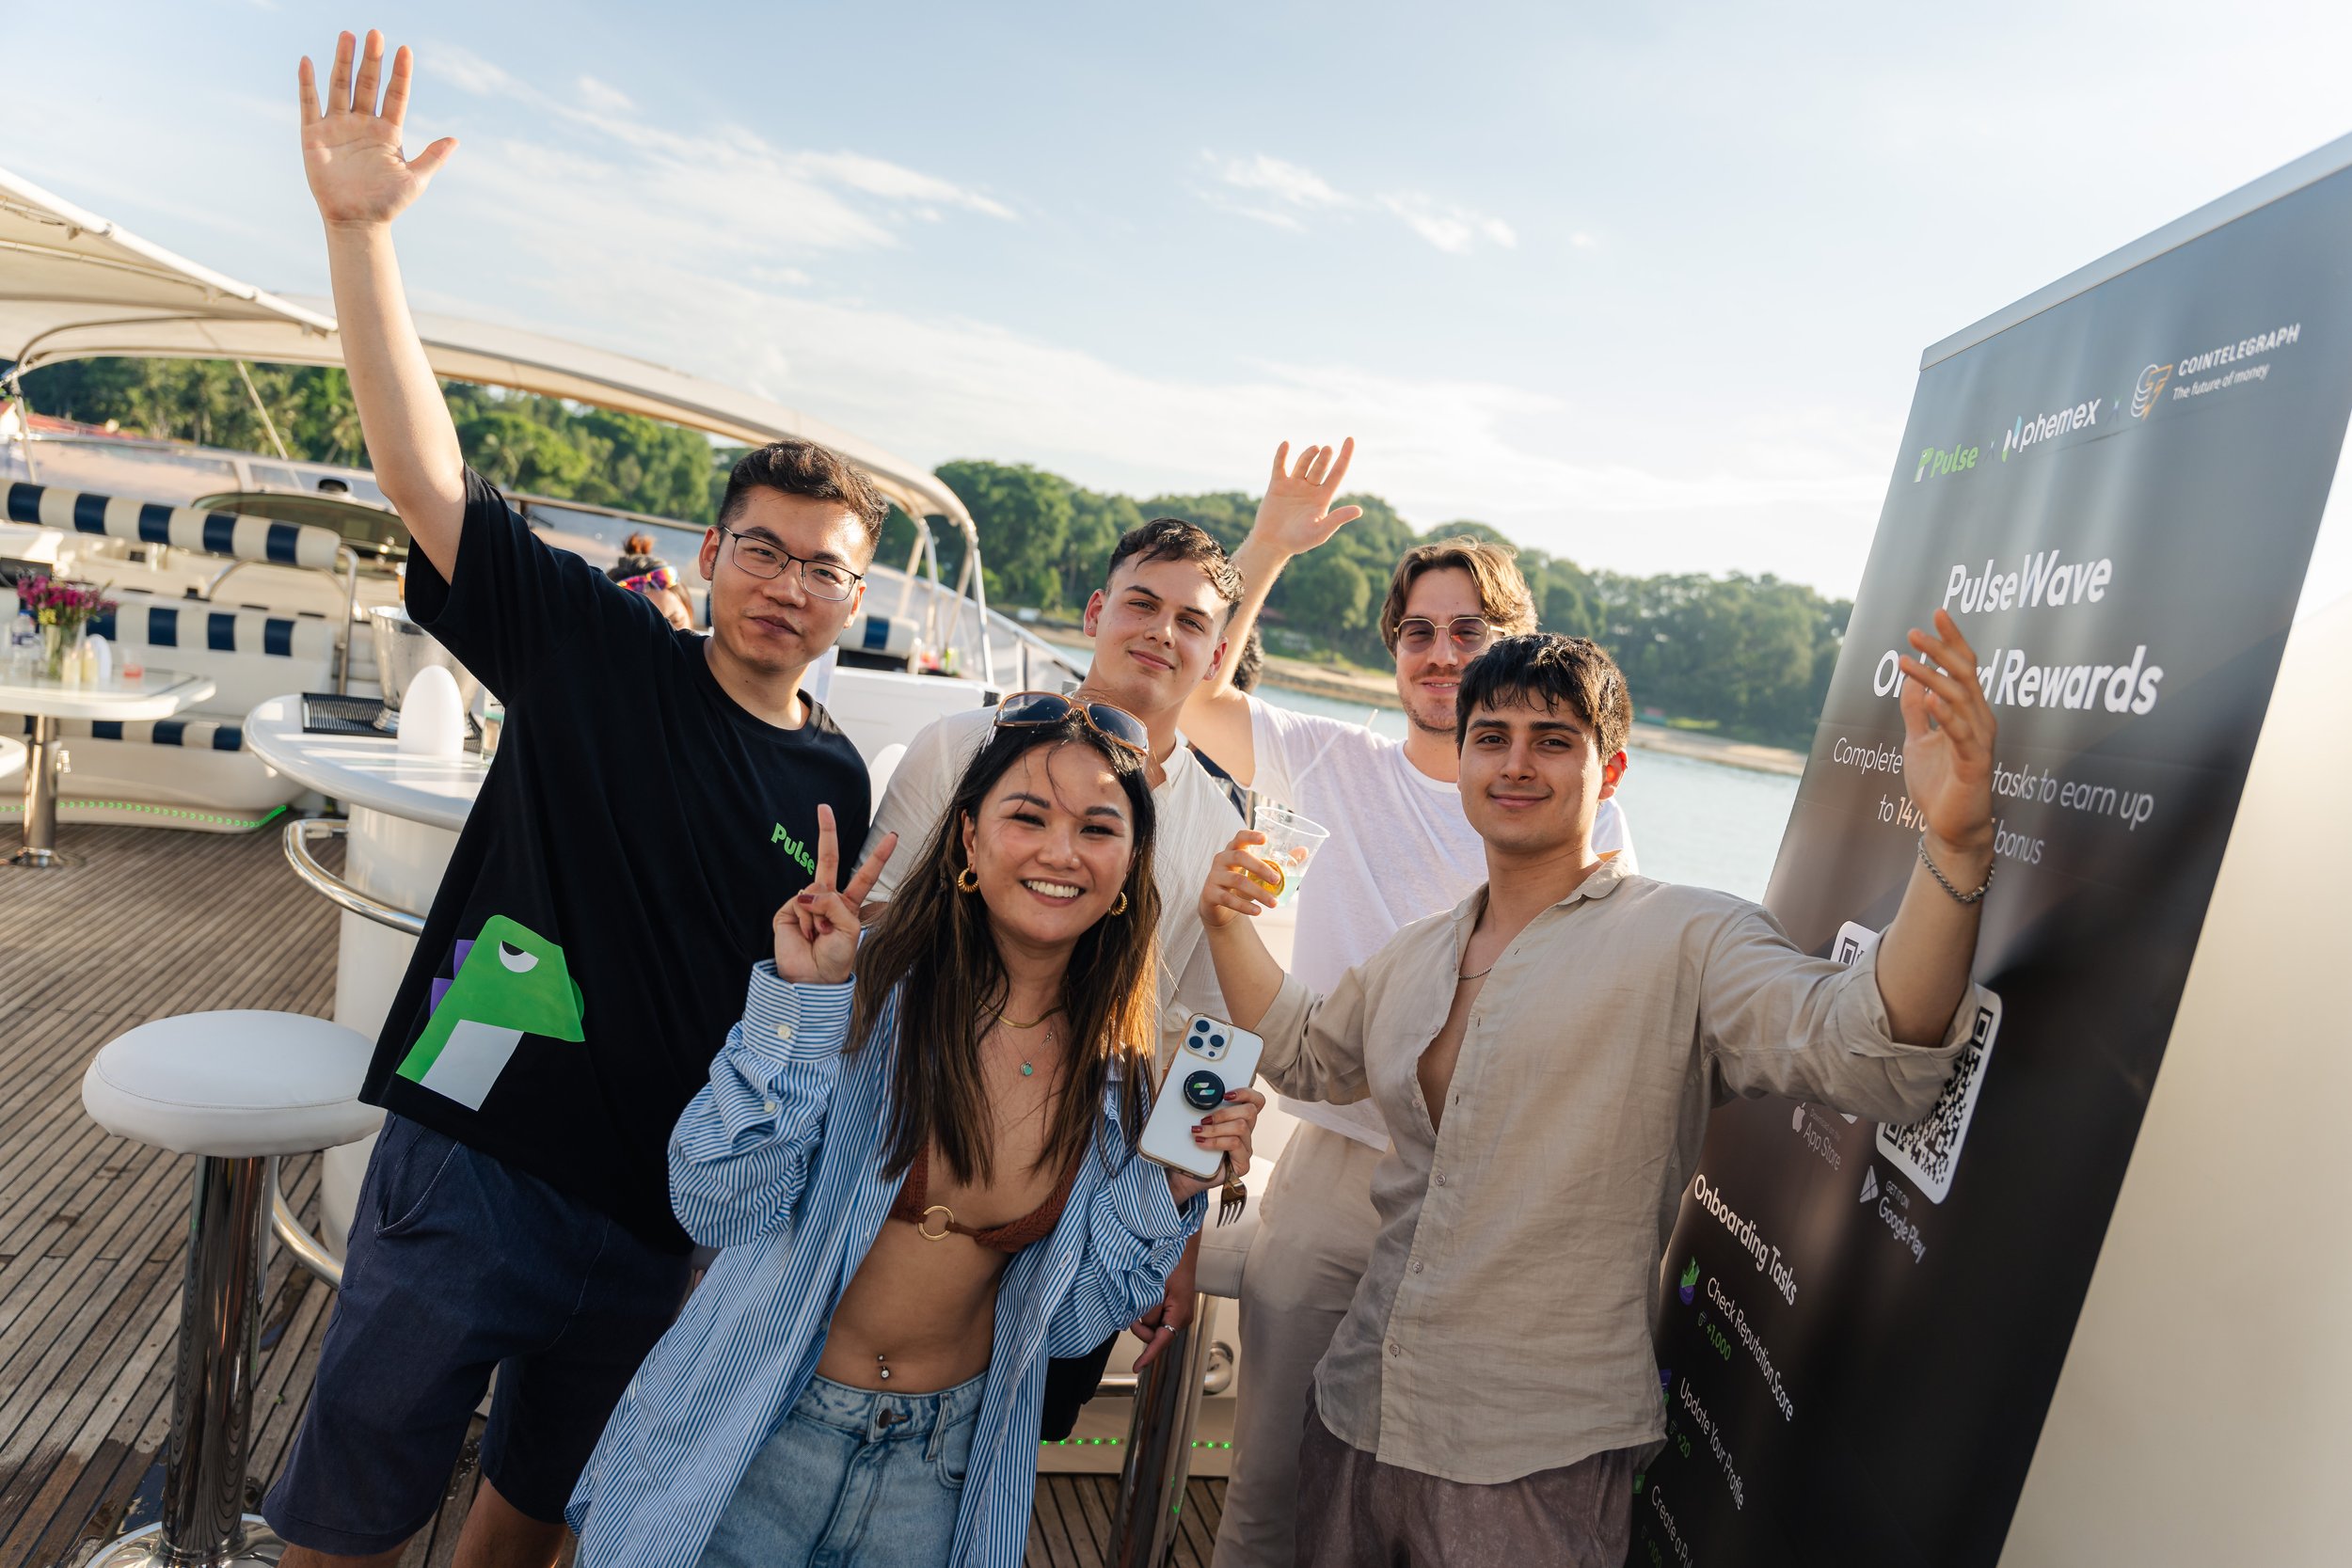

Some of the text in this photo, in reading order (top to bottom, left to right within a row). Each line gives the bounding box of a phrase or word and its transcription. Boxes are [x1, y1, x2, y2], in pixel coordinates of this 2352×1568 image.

[2178, 323, 2301, 377] COINTELEGRAPH
[2172, 363, 2271, 401] The future of money
[1930, 399, 2102, 478] Pulse phemex
[1942, 549, 2113, 614] PulseWave
[1994, 644, 2164, 716] Rewards
[1834, 736, 1903, 775] Complete
[1878, 793, 1894, 822] to
[1991, 761, 2154, 832] tasks to earn up
[771, 822, 816, 876] Pulse
[1993, 819, 2045, 864] bonus
[1803, 1122, 1821, 1152] App
[1820, 1136, 1842, 1171] Store
[1885, 1180, 1898, 1196] GET
[1694, 1174, 1797, 1306] Onboarding Tasks
[1878, 1196, 1927, 1264] Google Play
[1707, 1323, 1732, 1361] +1,000
[1707, 1276, 1793, 1422] Check Reputation Score
[1677, 1433, 1692, 1458] +20
[1679, 1377, 1744, 1511] Update Your Profile
[1652, 1485, 1677, 1542] Create
[1675, 1536, 1682, 1554] a
